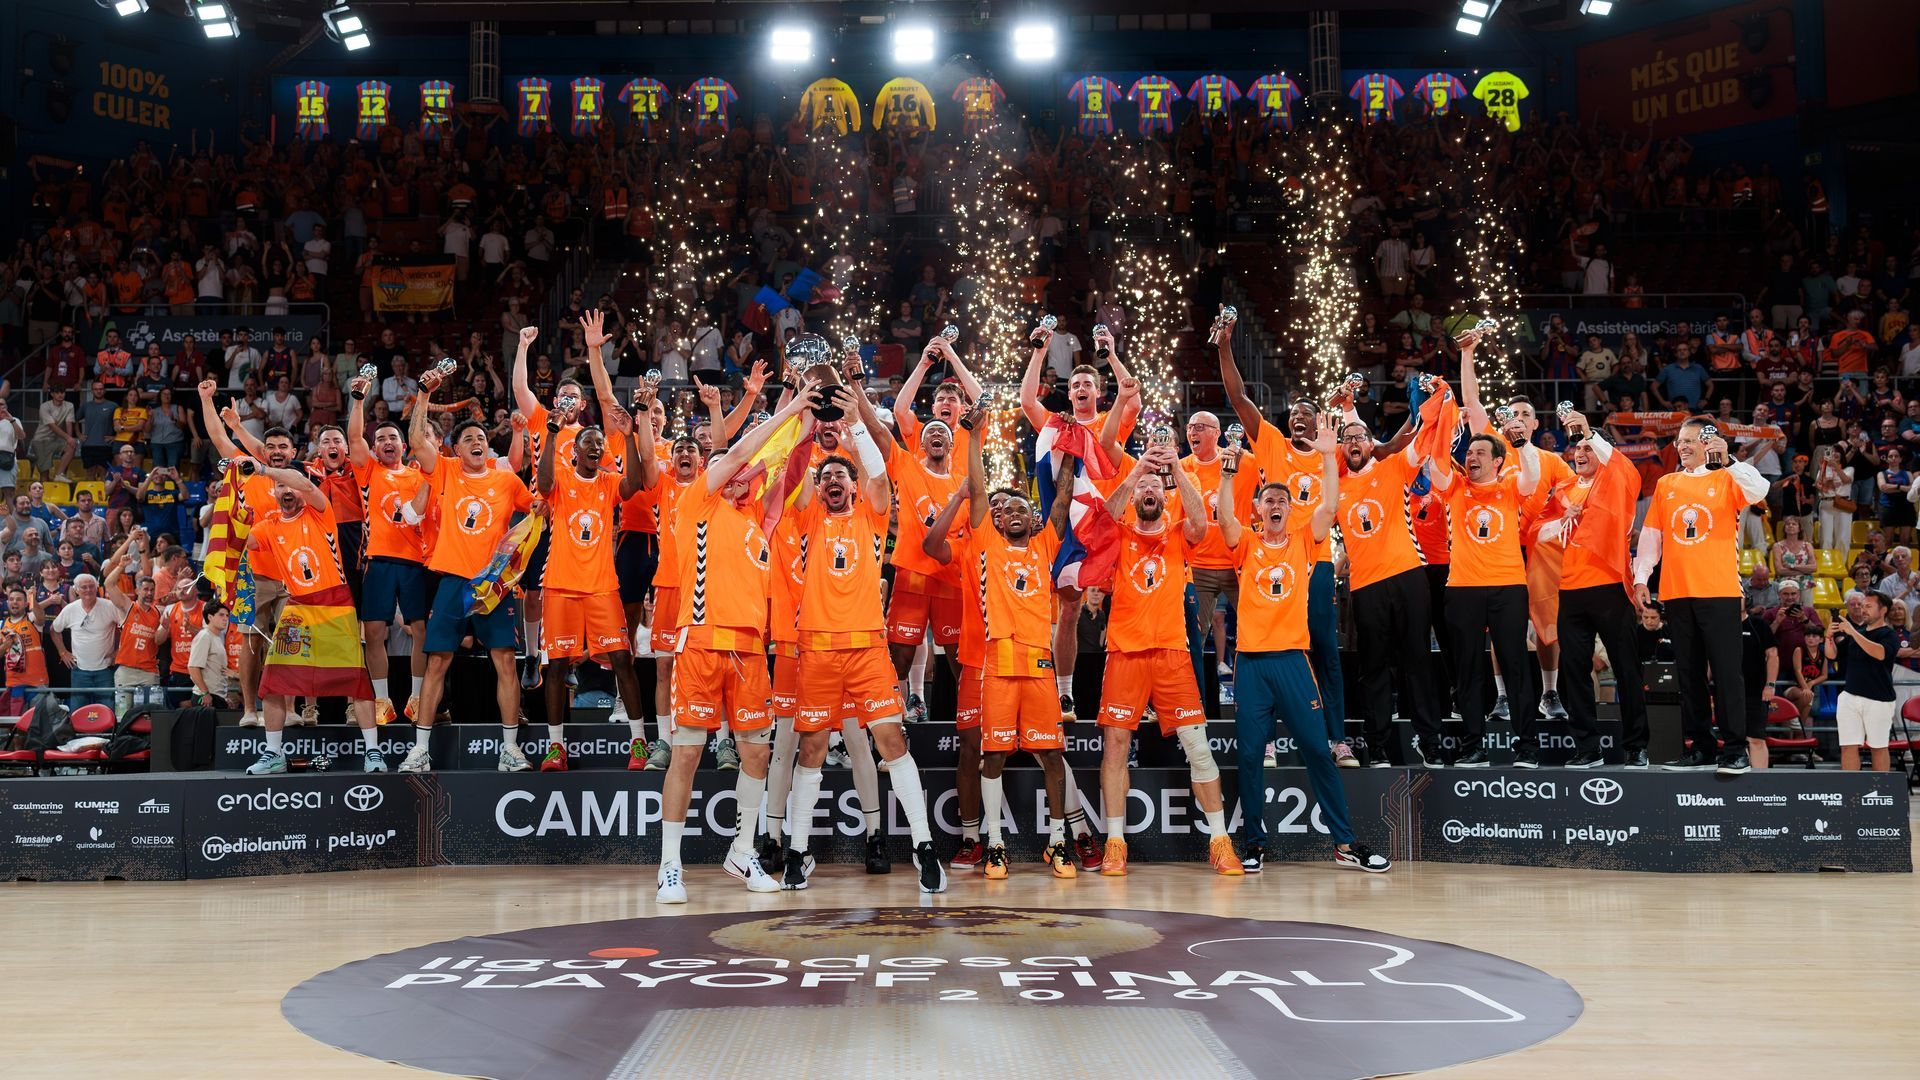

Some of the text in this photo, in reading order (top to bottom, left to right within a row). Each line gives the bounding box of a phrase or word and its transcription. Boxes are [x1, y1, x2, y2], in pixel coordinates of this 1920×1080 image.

[1631, 42, 1739, 91] MÉS QUE
[99, 61, 169, 99] 100%
[299, 97, 325, 116] 15
[361, 97, 386, 116] 12
[424, 97, 447, 116] 11
[527, 94, 541, 112] 7
[580, 94, 595, 112] 4
[632, 94, 657, 112] 21
[704, 93, 719, 111] 9
[824, 95, 835, 113] 1
[890, 94, 918, 113] 16
[1087, 91, 1102, 110] 8
[1147, 91, 1162, 110] 7
[1207, 91, 1222, 110] 5
[1267, 91, 1282, 110] 4
[1370, 89, 1384, 109] 2
[1432, 88, 1447, 108] 9
[1487, 89, 1515, 107] 28
[1632, 78, 1739, 124] UN CLUB
[93, 91, 171, 130] CULER
[134, 638, 146, 650] 15
[690, 705, 714, 717] PULEVA
[867, 699, 896, 712] Midea
[1108, 706, 1131, 716] PULEVA
[1177, 708, 1202, 719] Midea
[1028, 729, 1056, 741] Midea
[1454, 776, 1556, 799] endesa
[13, 802, 63, 810] azulmarino
[75, 801, 119, 809] KUMHO
[217, 787, 322, 811] endesa
[1676, 793, 1727, 806] Wilson
[1737, 794, 1787, 802] azulmarino
[1798, 793, 1842, 801] KUMHO
[1861, 797, 1893, 805] LOTUS
[888, 789, 1019, 836] LGA
[15, 835, 55, 844] Transaher
[131, 836, 175, 844] ONEBOX
[1445, 821, 1543, 842] mediolanum
[1566, 825, 1628, 845] pelayo
[1741, 827, 1781, 836] Transaher
[1857, 828, 1901, 837] ONEBOX
[204, 836, 307, 858] mediolanum
[329, 831, 386, 852] pelayo
[422, 955, 1092, 983] liga endesa
[385, 971, 1366, 990] PLAYOFF FINAL
[937, 988, 1218, 1002] 2026
